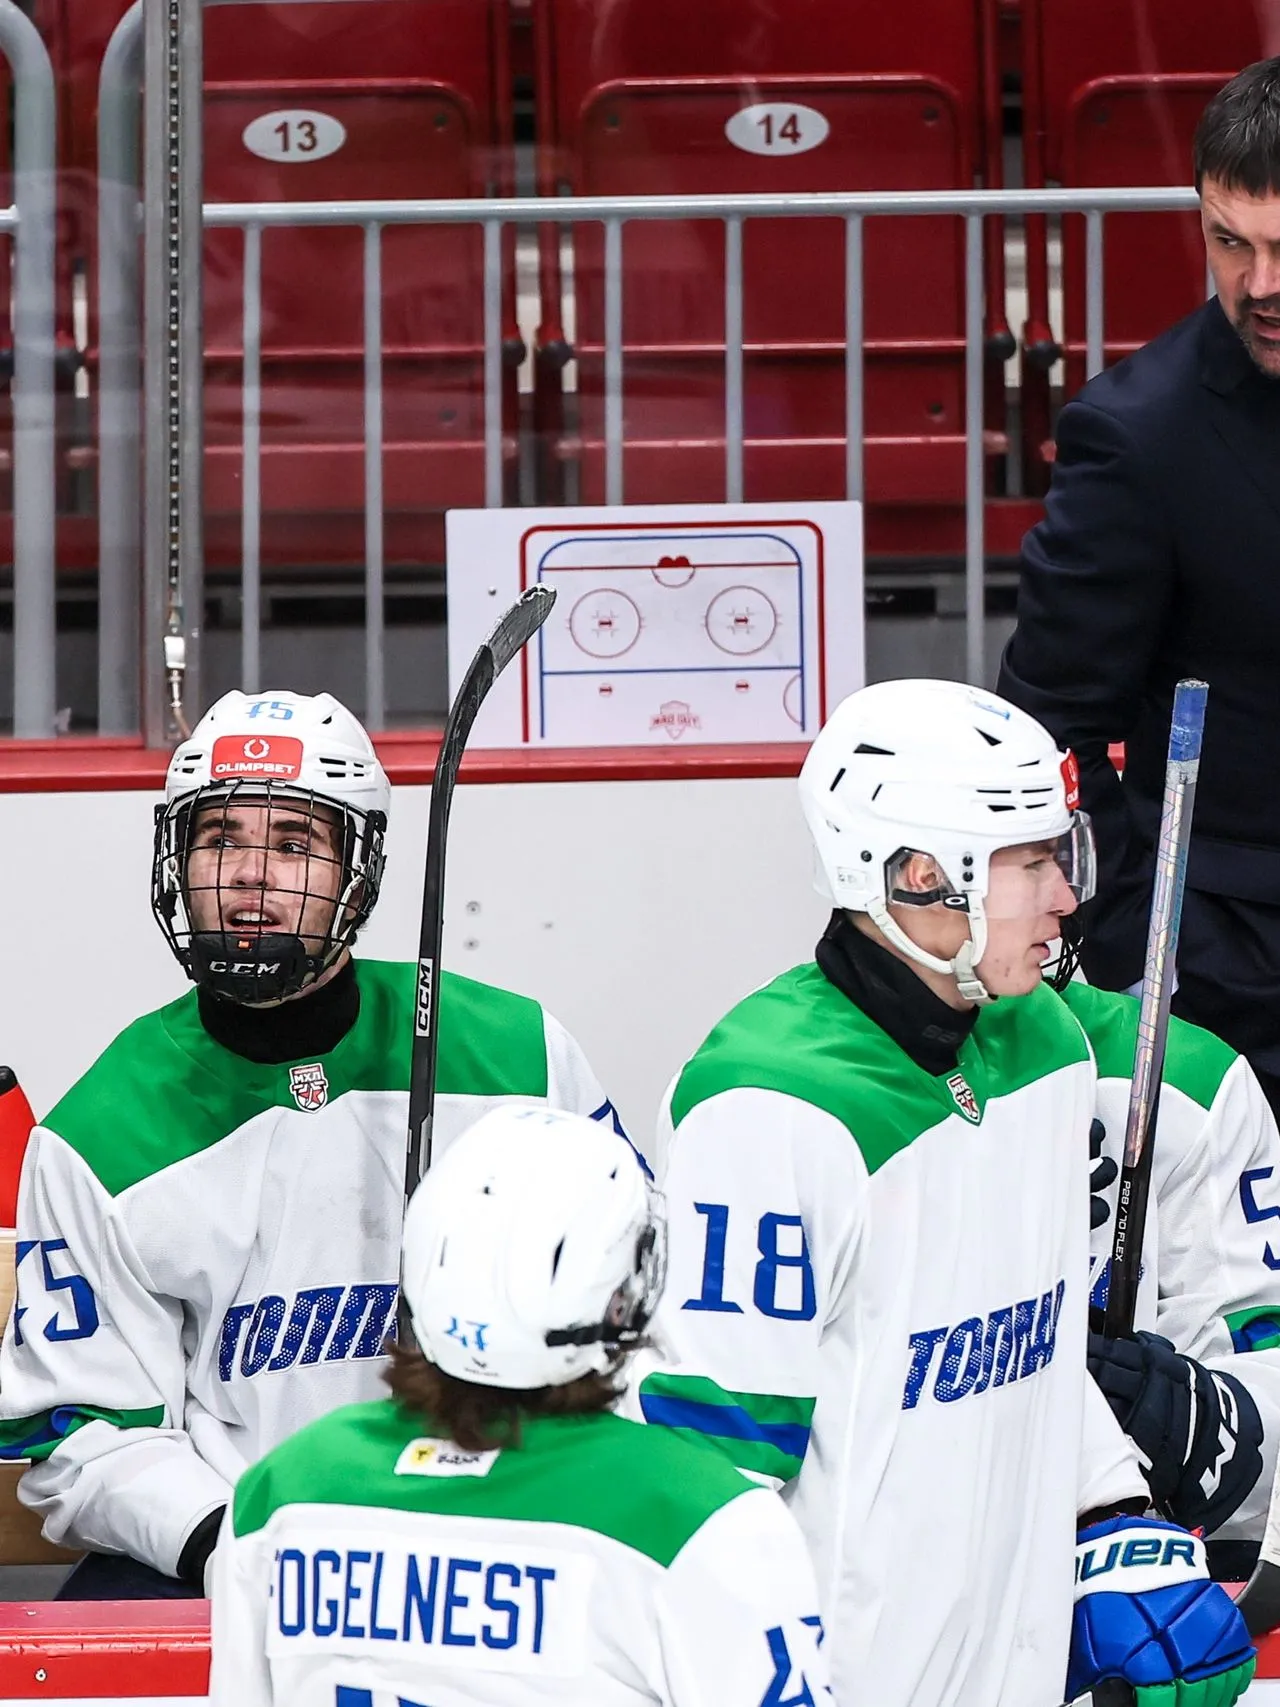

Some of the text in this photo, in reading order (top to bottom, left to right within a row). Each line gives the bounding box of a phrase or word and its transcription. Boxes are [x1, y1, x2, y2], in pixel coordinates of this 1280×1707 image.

[273, 120, 318, 153] 13
[757, 113, 802, 146] 14
[246, 700, 296, 721] 75
[214, 762, 297, 775] OLIMPBET
[208, 960, 281, 977] CCM
[416, 963, 431, 1032] CCM
[293, 1069, 324, 1084] МХЛ
[1121, 1180, 1131, 1204] P28
[680, 1201, 817, 1321] 18
[1114, 1231, 1126, 1262] FLEX
[444, 1316, 489, 1352] 47
[1074, 1537, 1197, 1586] UER
[269, 1548, 556, 1655] OGELNEST
